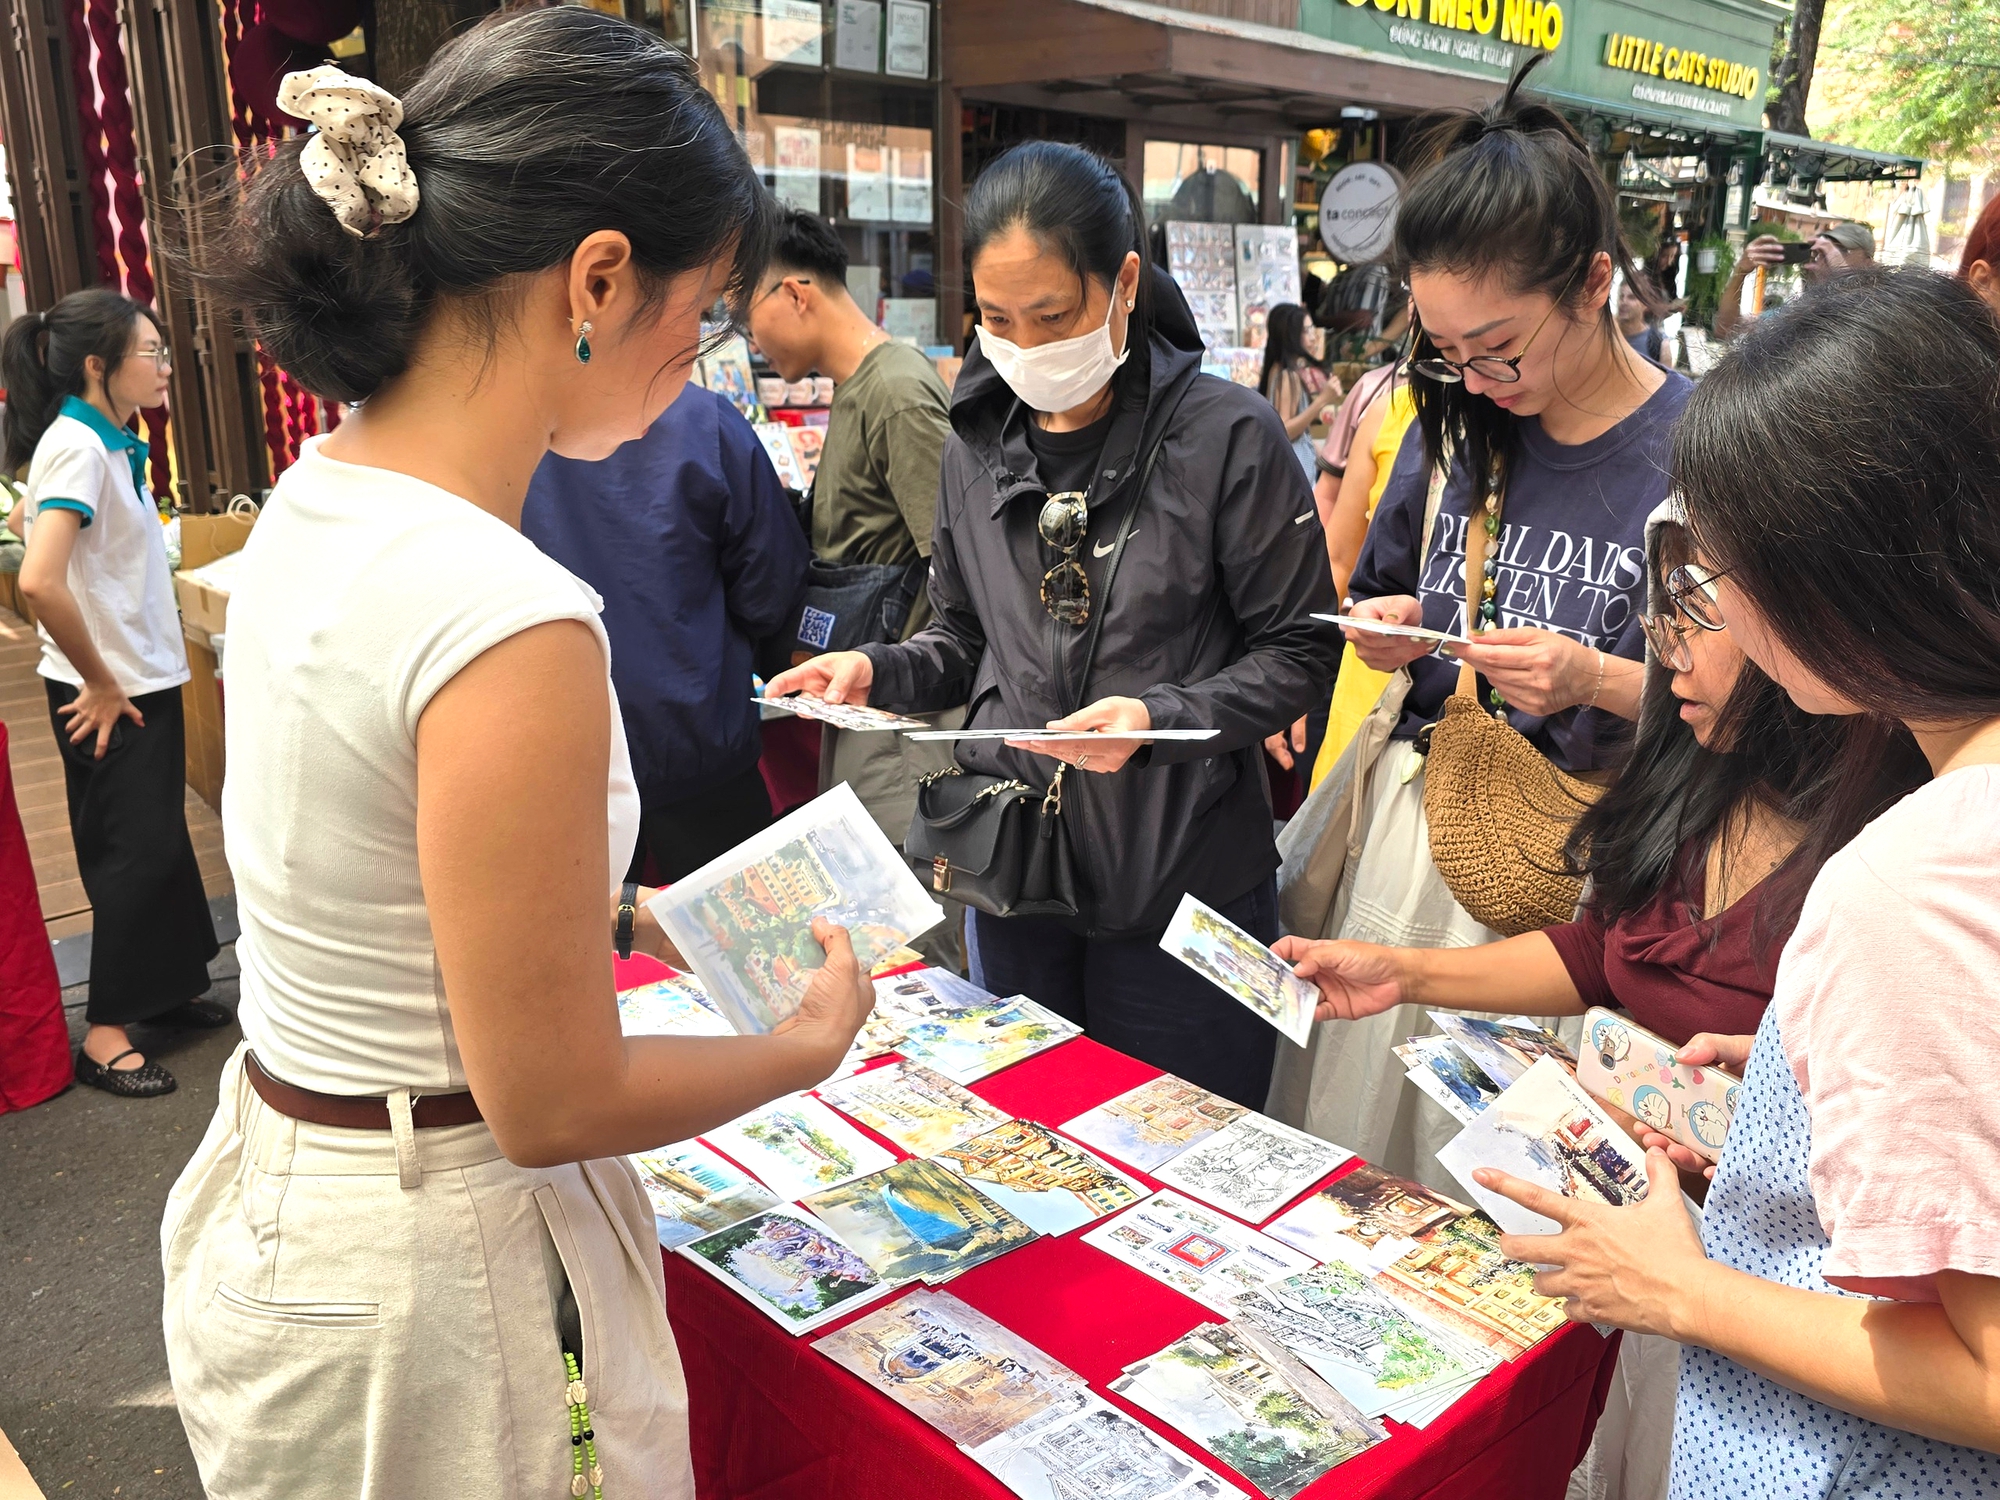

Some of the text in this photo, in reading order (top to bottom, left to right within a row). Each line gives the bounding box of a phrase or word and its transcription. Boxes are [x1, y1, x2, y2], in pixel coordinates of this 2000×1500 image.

[1607, 32, 1759, 101] LITTLE CATS STUDIO
[1326, 208, 1339, 221] ta
[1533, 530, 1647, 591] DADS
[1576, 585, 1631, 634] TO
